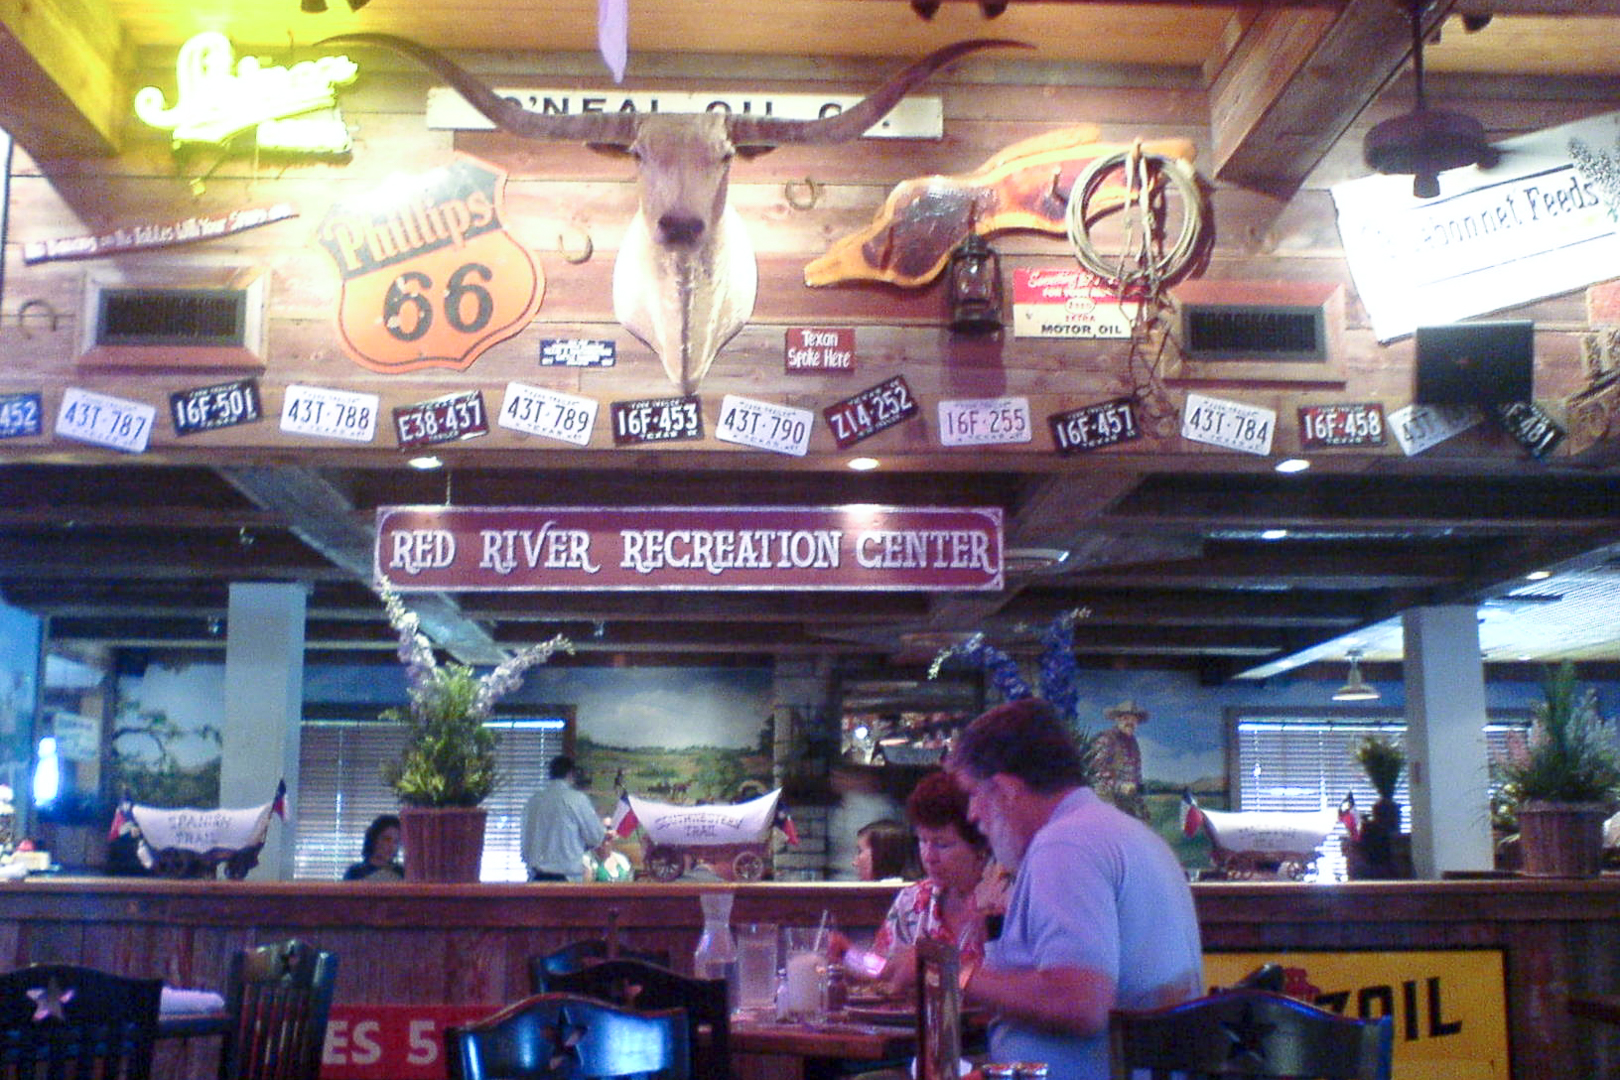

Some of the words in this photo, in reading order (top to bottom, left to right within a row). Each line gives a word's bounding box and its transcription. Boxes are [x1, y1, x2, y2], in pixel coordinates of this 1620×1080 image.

[1524, 176, 1600, 221] Feeds
[322, 190, 495, 272] Phillips
[383, 263, 494, 342] 66
[801, 329, 839, 347] Texan
[1041, 324, 1092, 335] MOTOR
[1099, 324, 1122, 334] OIL
[824, 347, 851, 368] Here
[390, 530, 456, 573] RED
[478, 519, 602, 574] RIVER
[619, 529, 843, 576] RECREATION
[855, 529, 999, 575] CENTER
